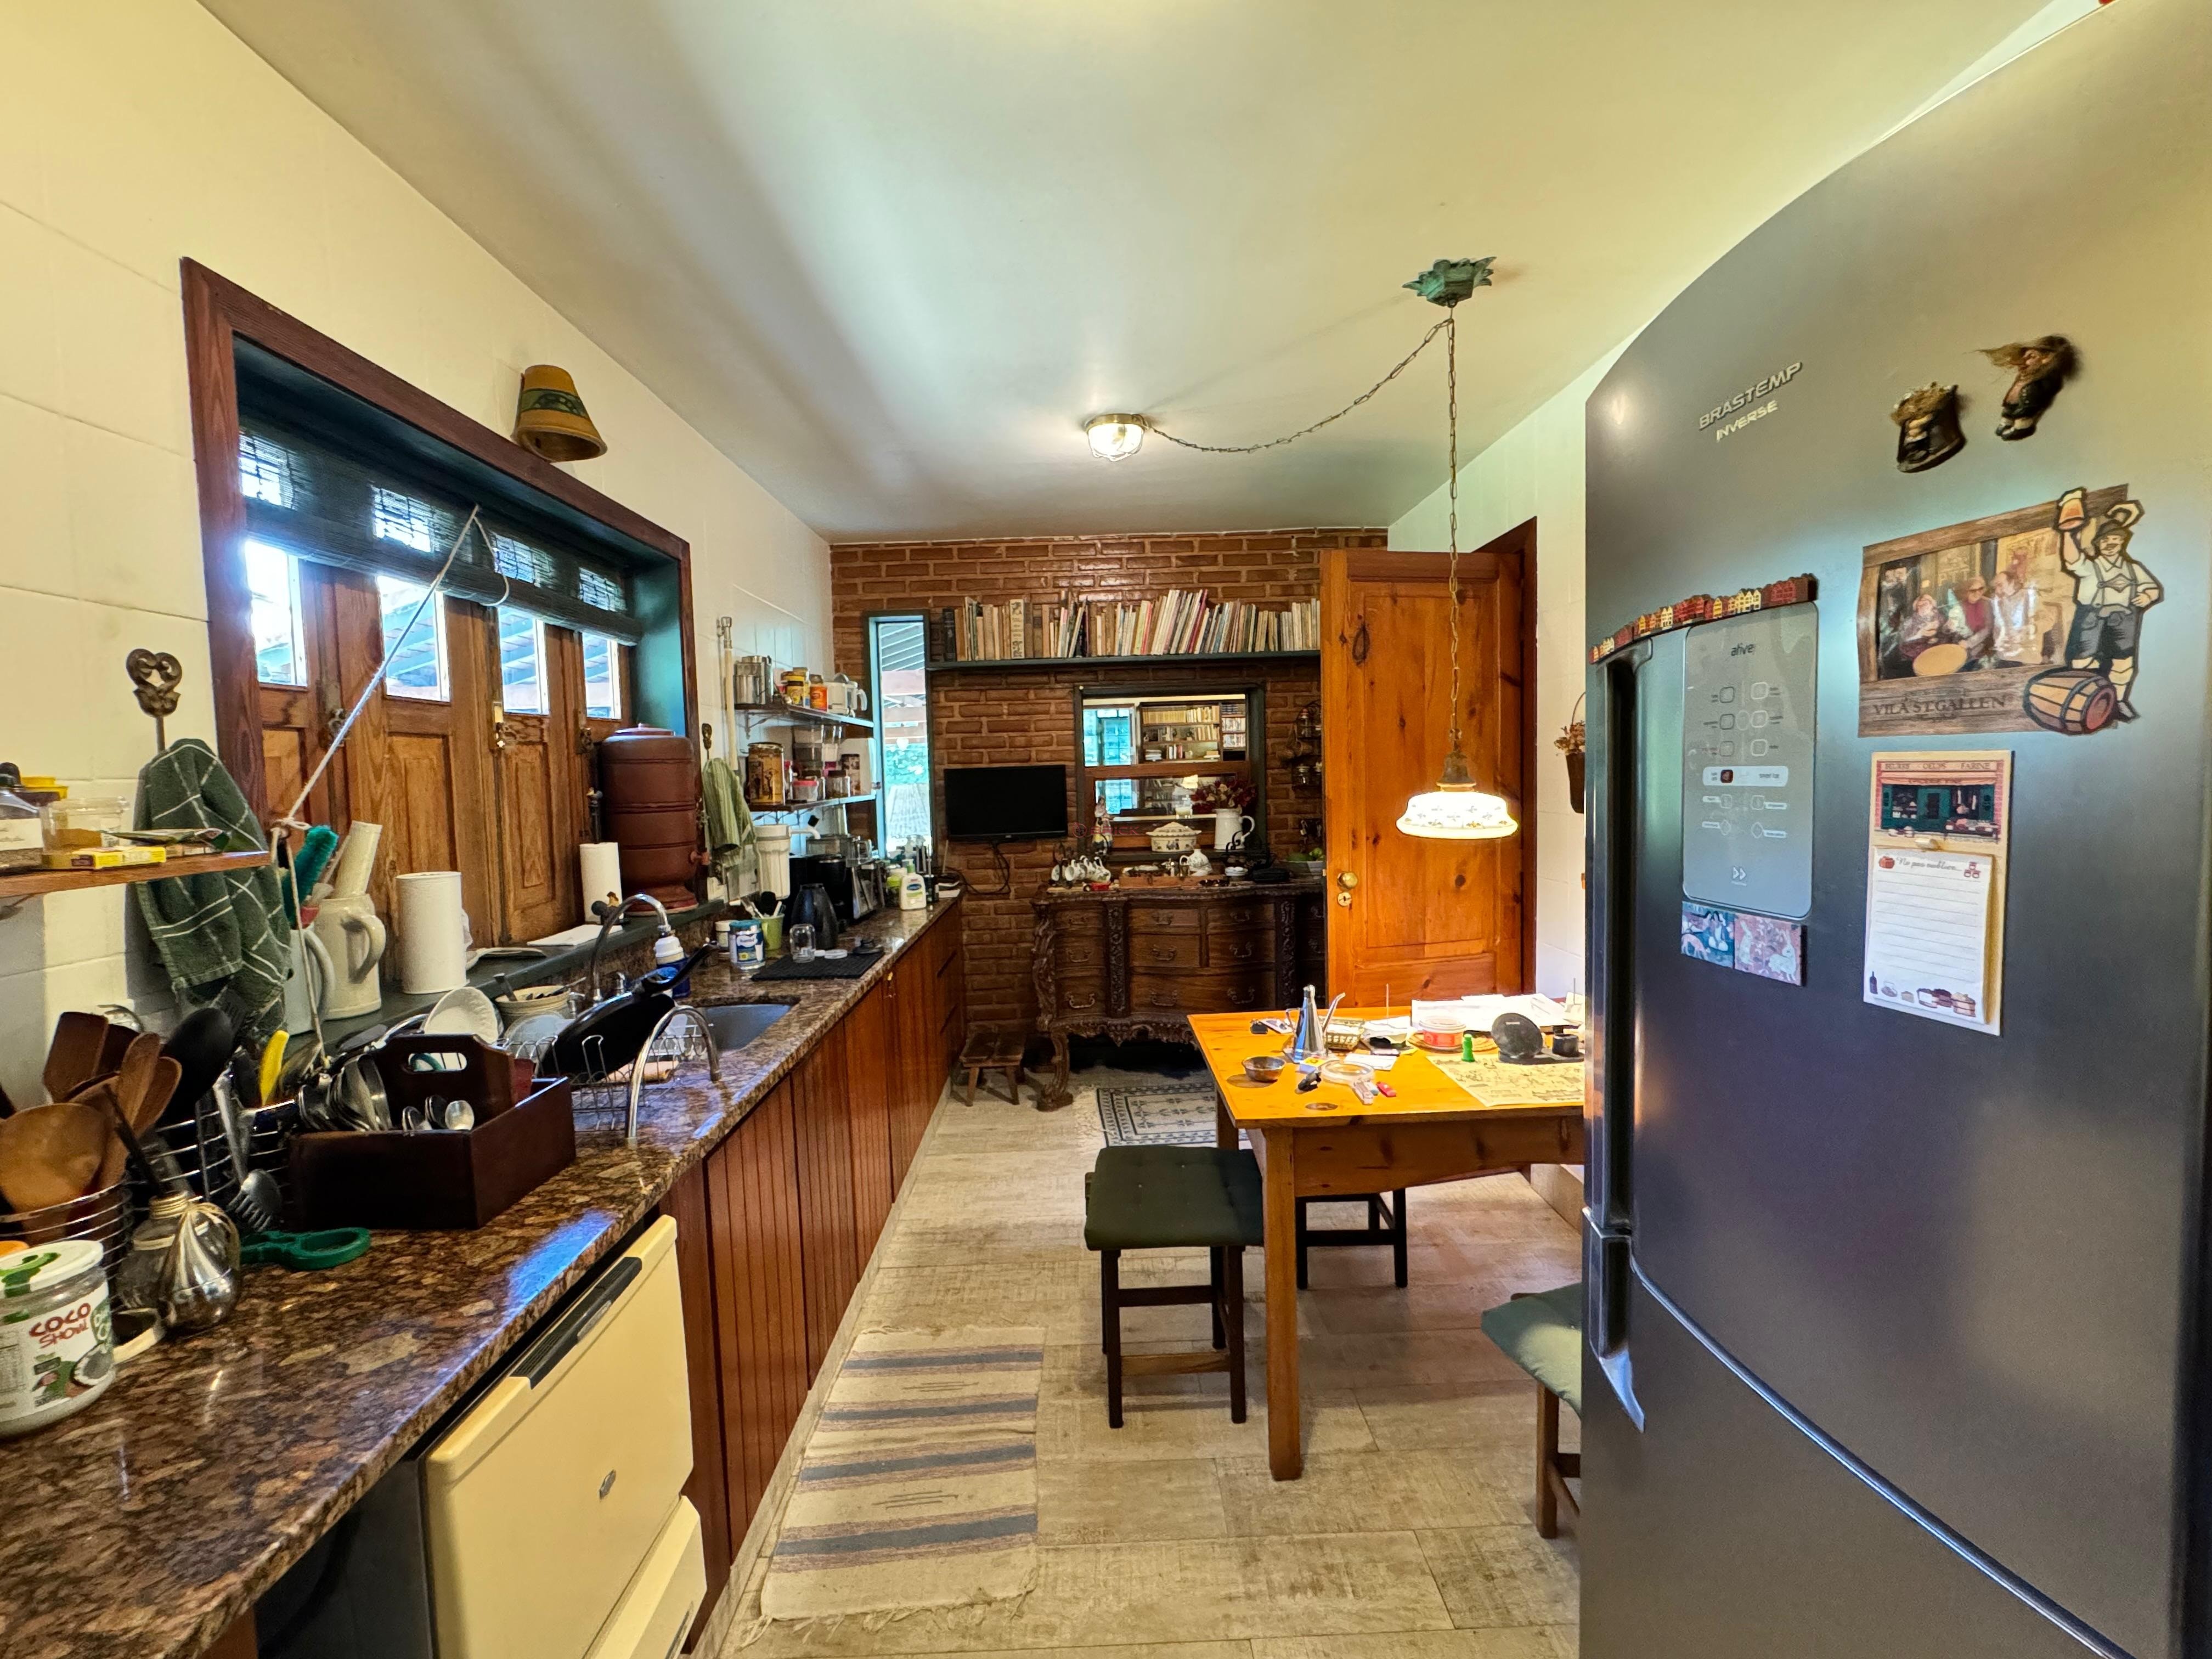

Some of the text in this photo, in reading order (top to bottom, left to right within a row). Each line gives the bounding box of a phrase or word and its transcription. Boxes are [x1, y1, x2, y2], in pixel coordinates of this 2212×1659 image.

[1699, 362, 1802, 430] BRASTEMP
[1716, 400, 1779, 442] INVERSE
[29, 1302, 91, 1337] COCO
